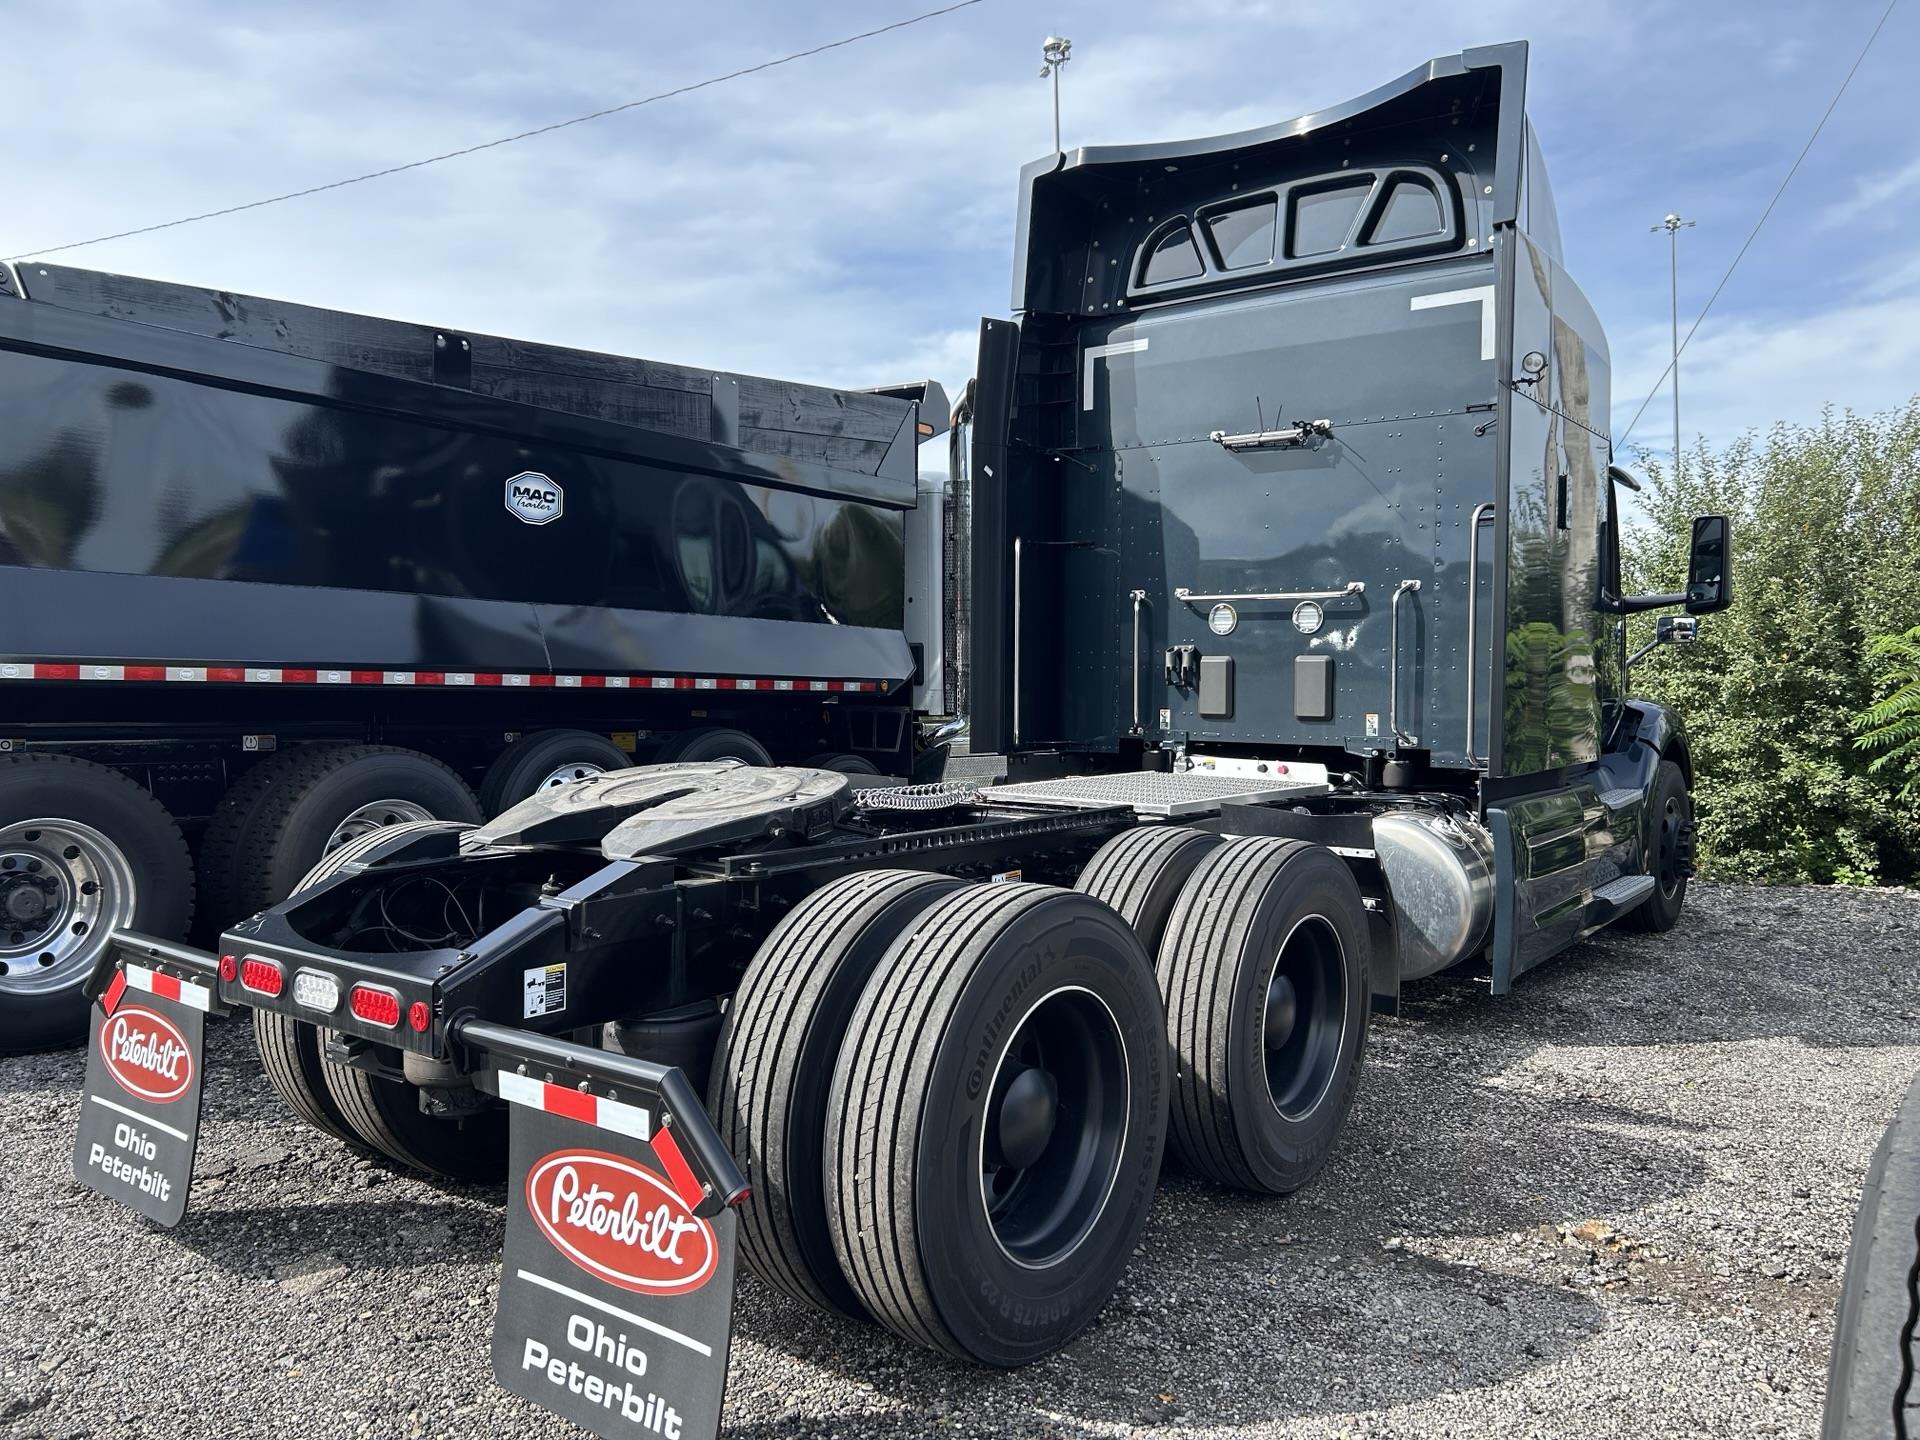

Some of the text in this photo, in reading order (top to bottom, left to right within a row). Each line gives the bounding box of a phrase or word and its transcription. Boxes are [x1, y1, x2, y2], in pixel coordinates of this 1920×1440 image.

[513, 486, 556, 503] MAC
[515, 495, 552, 510] Trailer
[111, 1017, 186, 1081] Peterbilt
[966, 951, 1043, 1101] Continental
[88, 1142, 172, 1202] Peterbilt
[114, 1122, 157, 1161] Ohio
[551, 1165, 698, 1265] Peterbilt
[567, 1314, 648, 1376] Ohio
[522, 1337, 683, 1440] Peterbilt
